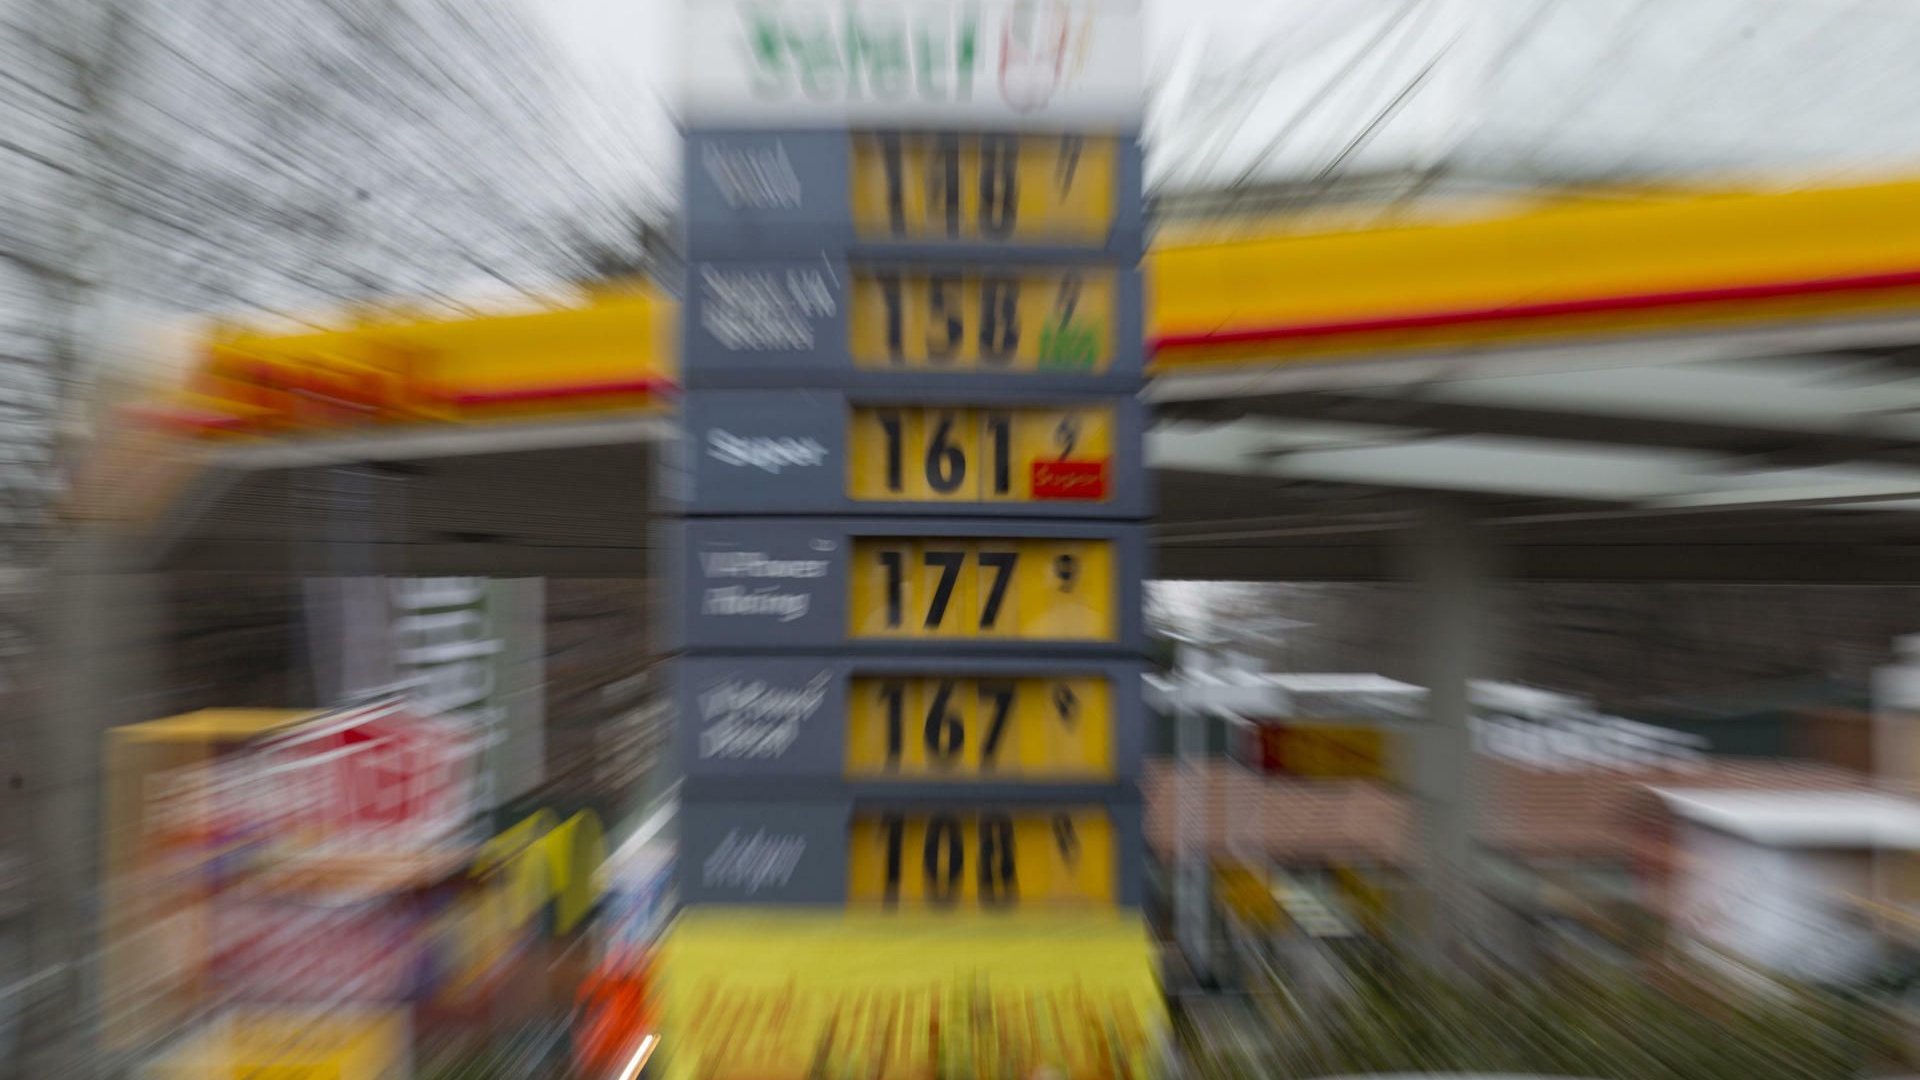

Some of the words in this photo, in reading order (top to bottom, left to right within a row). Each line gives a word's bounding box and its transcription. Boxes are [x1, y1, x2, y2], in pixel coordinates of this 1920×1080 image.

[876, 266, 1021, 366] 158
[880, 408, 1011, 494] 161
[880, 551, 1019, 630] 177
[1053, 554, 1081, 593] 9
[878, 678, 1018, 770] 167
[877, 810, 1020, 914] 108
